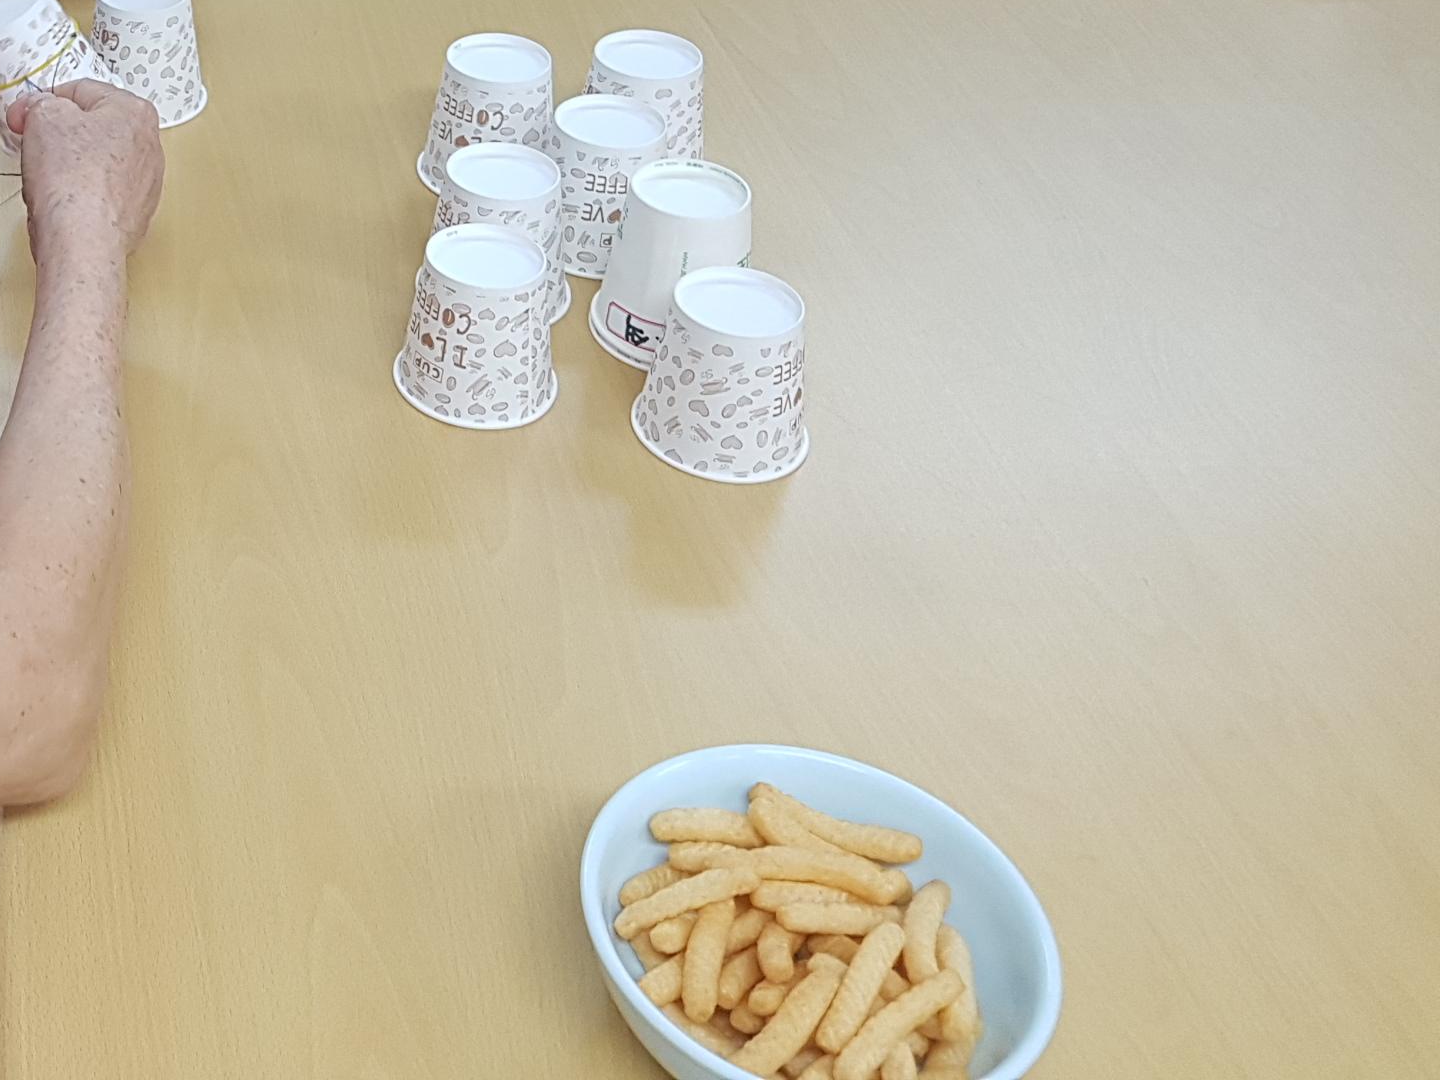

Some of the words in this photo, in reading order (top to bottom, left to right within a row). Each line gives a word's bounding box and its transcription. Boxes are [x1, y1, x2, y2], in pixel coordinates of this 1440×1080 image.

[443, 94, 505, 131] COFFEE
[584, 173, 628, 195] FFEE
[416, 284, 472, 335] COFFEE
[414, 356, 441, 379] CUP
